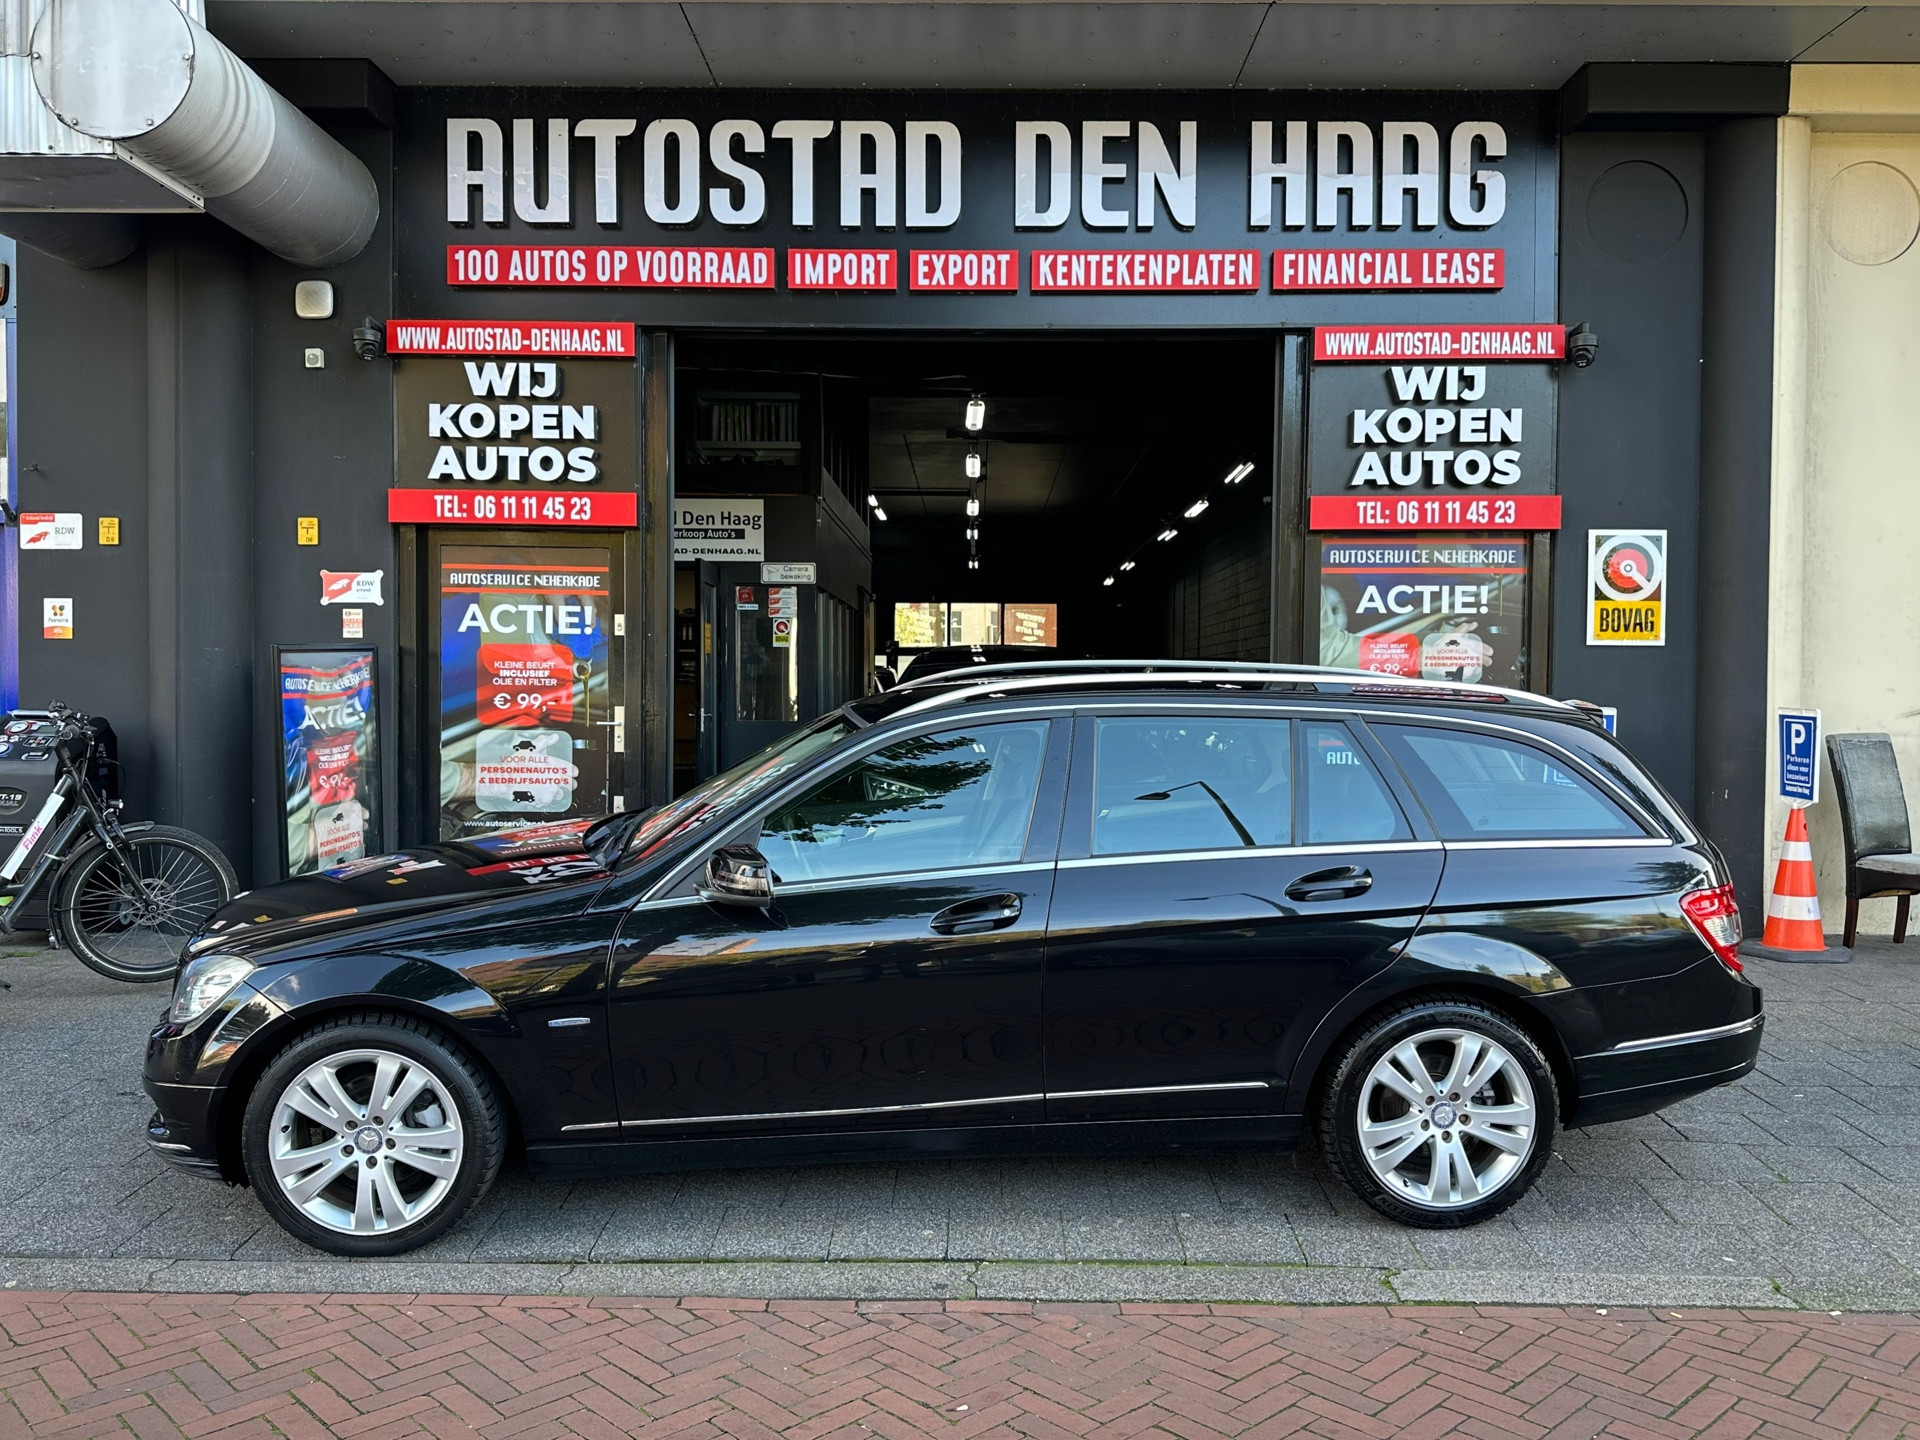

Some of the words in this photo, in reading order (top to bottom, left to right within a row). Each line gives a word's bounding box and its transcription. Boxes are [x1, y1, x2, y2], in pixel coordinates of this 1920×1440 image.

[446, 117, 963, 229] AUTOSTAD
[1015, 120, 1198, 229] DEN
[1249, 120, 1508, 228] HAAG
[454, 250, 499, 282] 100
[508, 251, 587, 283] AUTOS
[596, 252, 629, 283] OP
[637, 251, 769, 285] VOORRAAD
[794, 253, 891, 286] IMPORT
[917, 253, 1011, 286] EXPORT
[1038, 253, 1254, 287] KENTEKENPLATEN
[1282, 253, 1413, 286] FINANCIAL
[1422, 252, 1496, 285] LEASE
[396, 327, 626, 353] WWW.AUTOSTAD-DENHAAG.NL
[1324, 330, 1556, 357] WWW.AUTOSTAD-DENHAAG.NL
[464, 361, 558, 398] WIJ
[1389, 366, 1487, 401] WIJ
[428, 404, 596, 440] KOPEN
[1353, 408, 1523, 445] KOPEN
[427, 445, 597, 483] AUTOS
[1352, 450, 1522, 487] AUTOS
[434, 495, 468, 519] TEL:
[474, 496, 497, 520] 06
[500, 496, 518, 520] 11
[522, 497, 538, 520] 11
[540, 497, 565, 521] 45
[569, 498, 592, 522] 23
[683, 510, 716, 526] Den
[721, 510, 763, 530] Haag
[1357, 501, 1390, 525] TEL:
[1396, 502, 1420, 525] 06
[1423, 502, 1441, 526] 11
[1444, 502, 1461, 526] 11
[1465, 501, 1491, 526] 45
[1494, 501, 1516, 525] 23
[54, 527, 76, 535] RDW
[707, 530, 736, 538] Auto's
[1329, 549, 1431, 565] AUTOSERVICE
[1433, 549, 1517, 565] NEHERKADE
[449, 572, 530, 587] AUTOSERVICE
[533, 573, 601, 588] NEHERKADE
[780, 573, 812, 581] bewaking
[1356, 586, 1489, 615] ACTIE!
[456, 603, 594, 636] ACTIE!
[1599, 607, 1655, 634] BOVAG
[493, 660, 525, 669] KLEINE
[526, 661, 556, 670] BEURT
[499, 669, 550, 678] INCLUSIEF
[492, 677, 514, 686] OLIE
[514, 678, 527, 686] EN
[528, 678, 558, 687] FILTER
[493, 692, 511, 709] €
[516, 693, 557, 711] 99,-
[1791, 723, 1806, 755] P
[480, 766, 568, 775] PERSONENAUTO'S
[499, 755, 527, 764] VOOR
[528, 755, 549, 764] ALLE
[1786, 754, 1810, 764] Parkeren
[478, 777, 486, 785] &
[488, 777, 570, 786] BEDRIJFSAUTO'S
[22, 823, 43, 851] Flink
